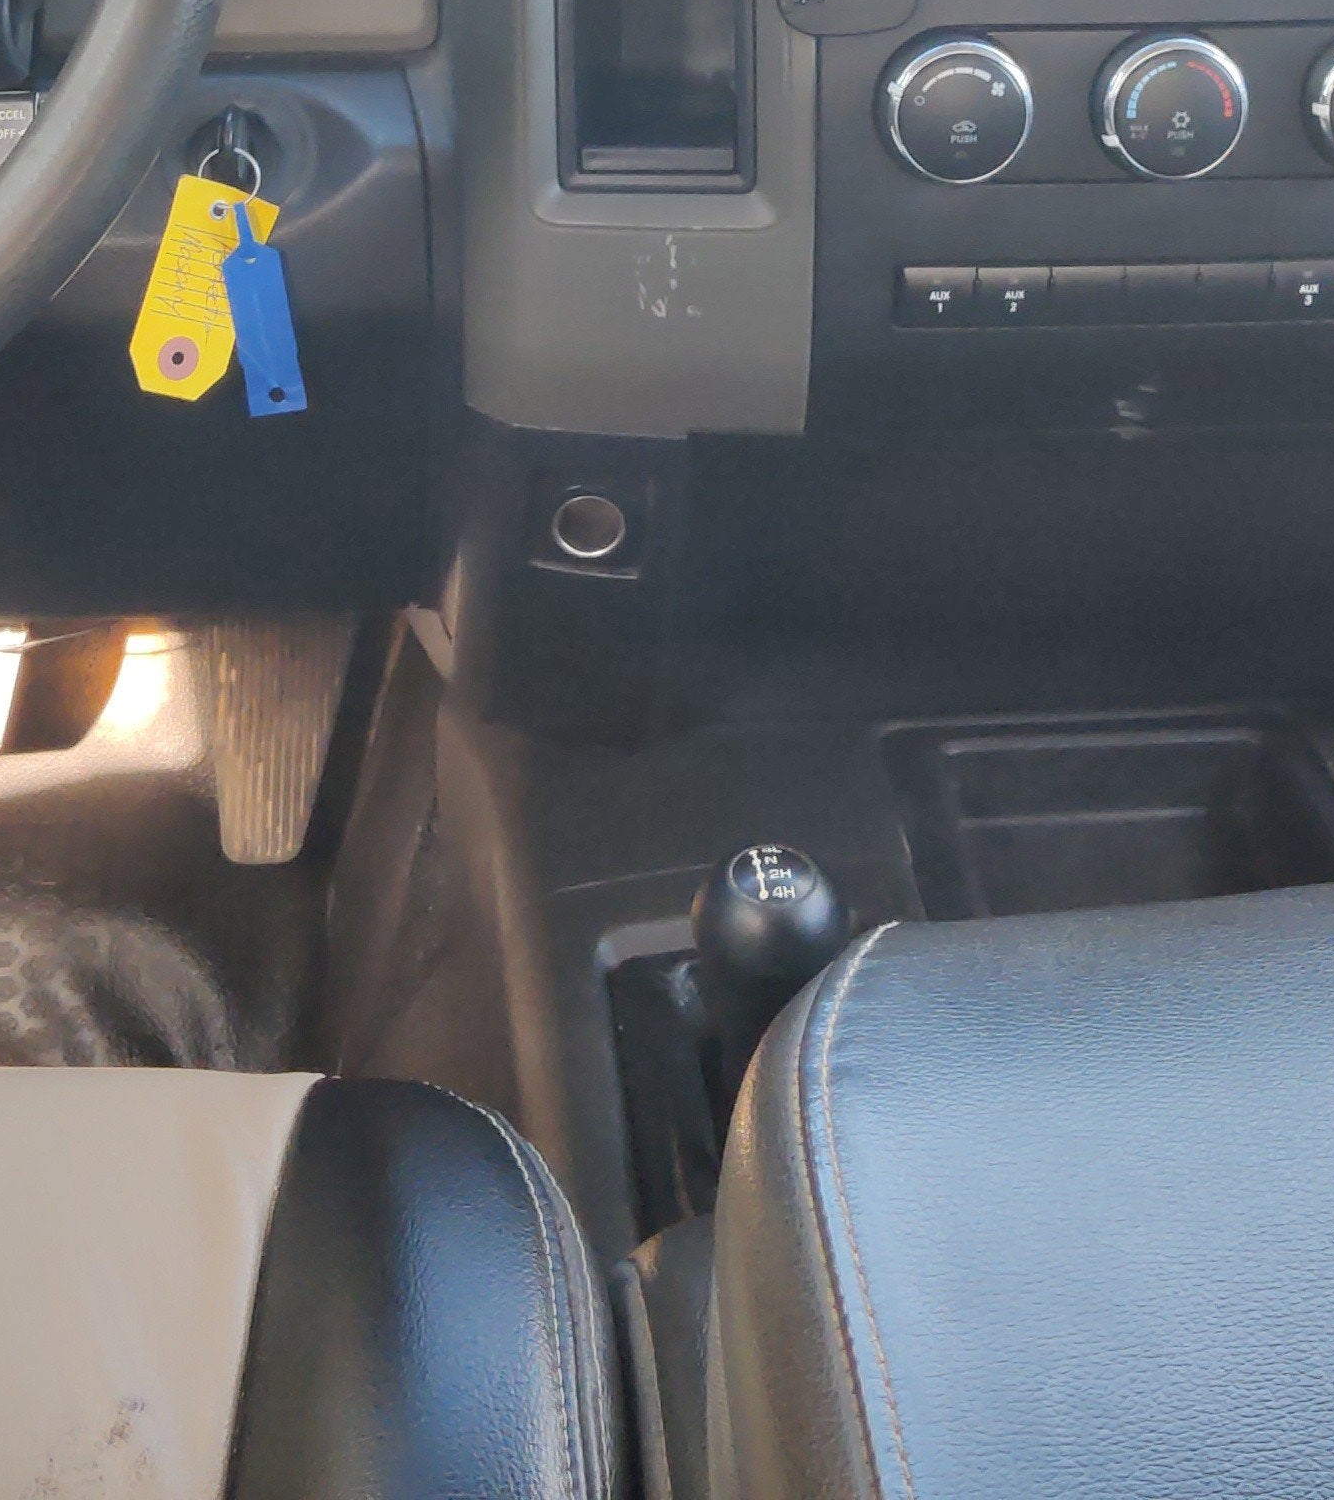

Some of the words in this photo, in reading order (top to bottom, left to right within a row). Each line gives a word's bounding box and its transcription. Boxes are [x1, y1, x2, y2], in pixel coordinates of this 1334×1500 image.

[950, 134, 978, 145] PUSH
[929, 289, 951, 301] AUX
[1004, 289, 1026, 301] AUX
[1298, 283, 1320, 295] AUX
[1303, 294, 1314, 307] 3
[937, 302, 944, 314] 1
[1009, 301, 1018, 313] 2
[763, 854, 778, 865] N
[768, 868, 792, 880] 2H
[771, 885, 796, 899] 4H
